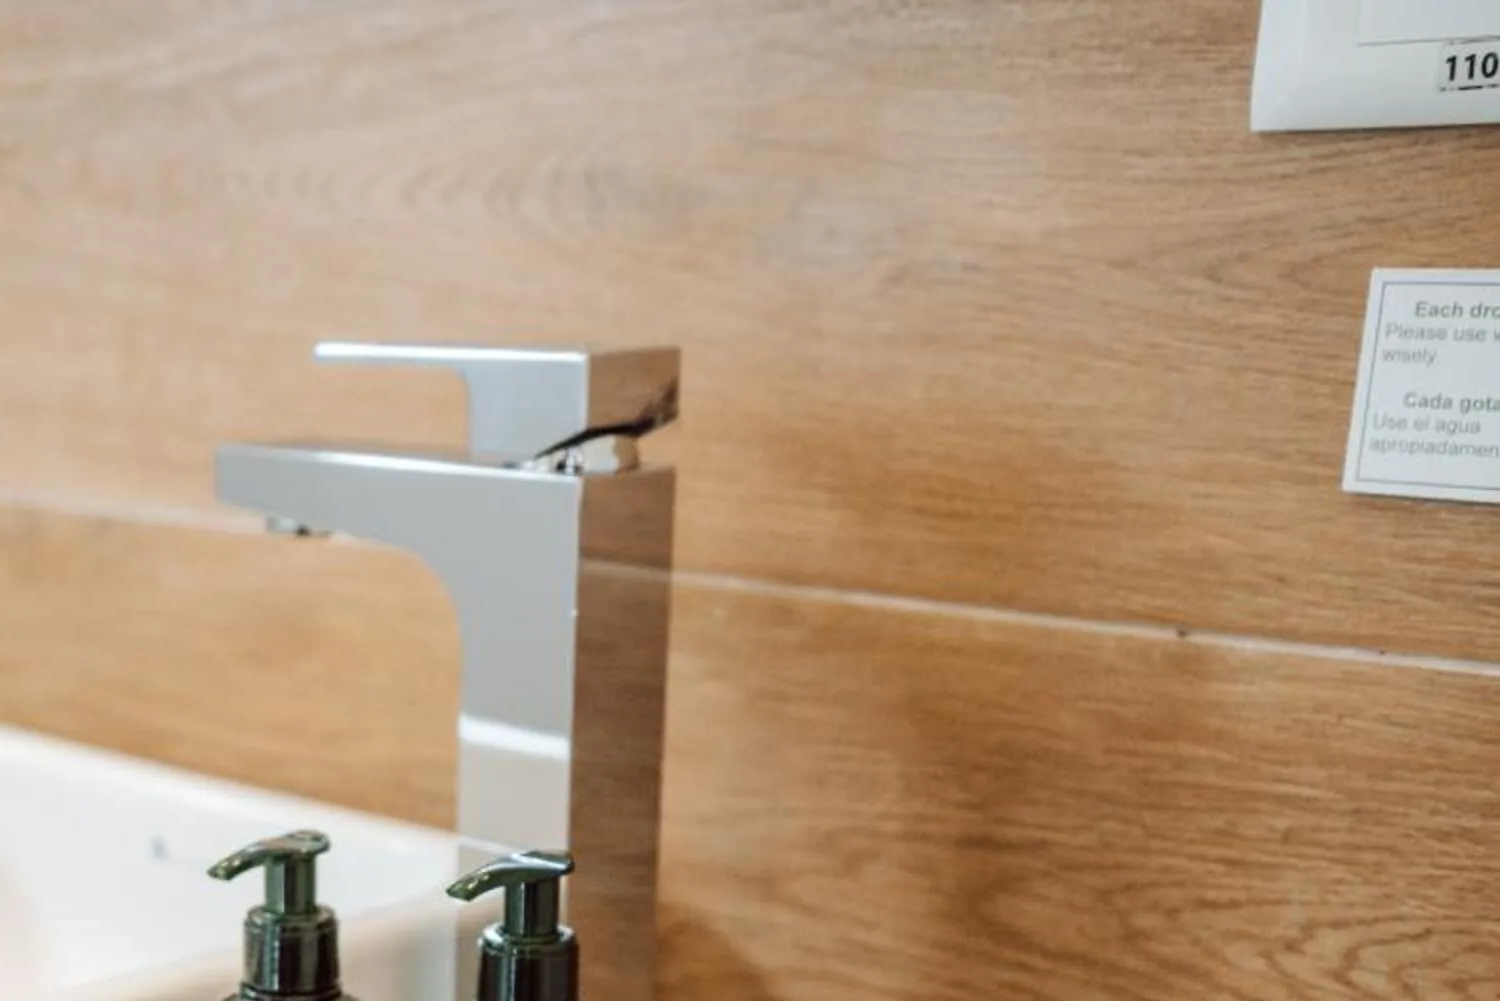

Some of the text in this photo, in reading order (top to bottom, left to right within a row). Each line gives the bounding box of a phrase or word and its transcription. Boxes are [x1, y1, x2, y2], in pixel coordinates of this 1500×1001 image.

[1445, 51, 1498, 81] 110
[1415, 300, 1464, 318] Each
[1384, 322, 1447, 341] Please
[1453, 327, 1487, 342] use
[1402, 391, 1453, 410] Cada
[1373, 412, 1408, 431] Use
[1435, 418, 1481, 436] agua
